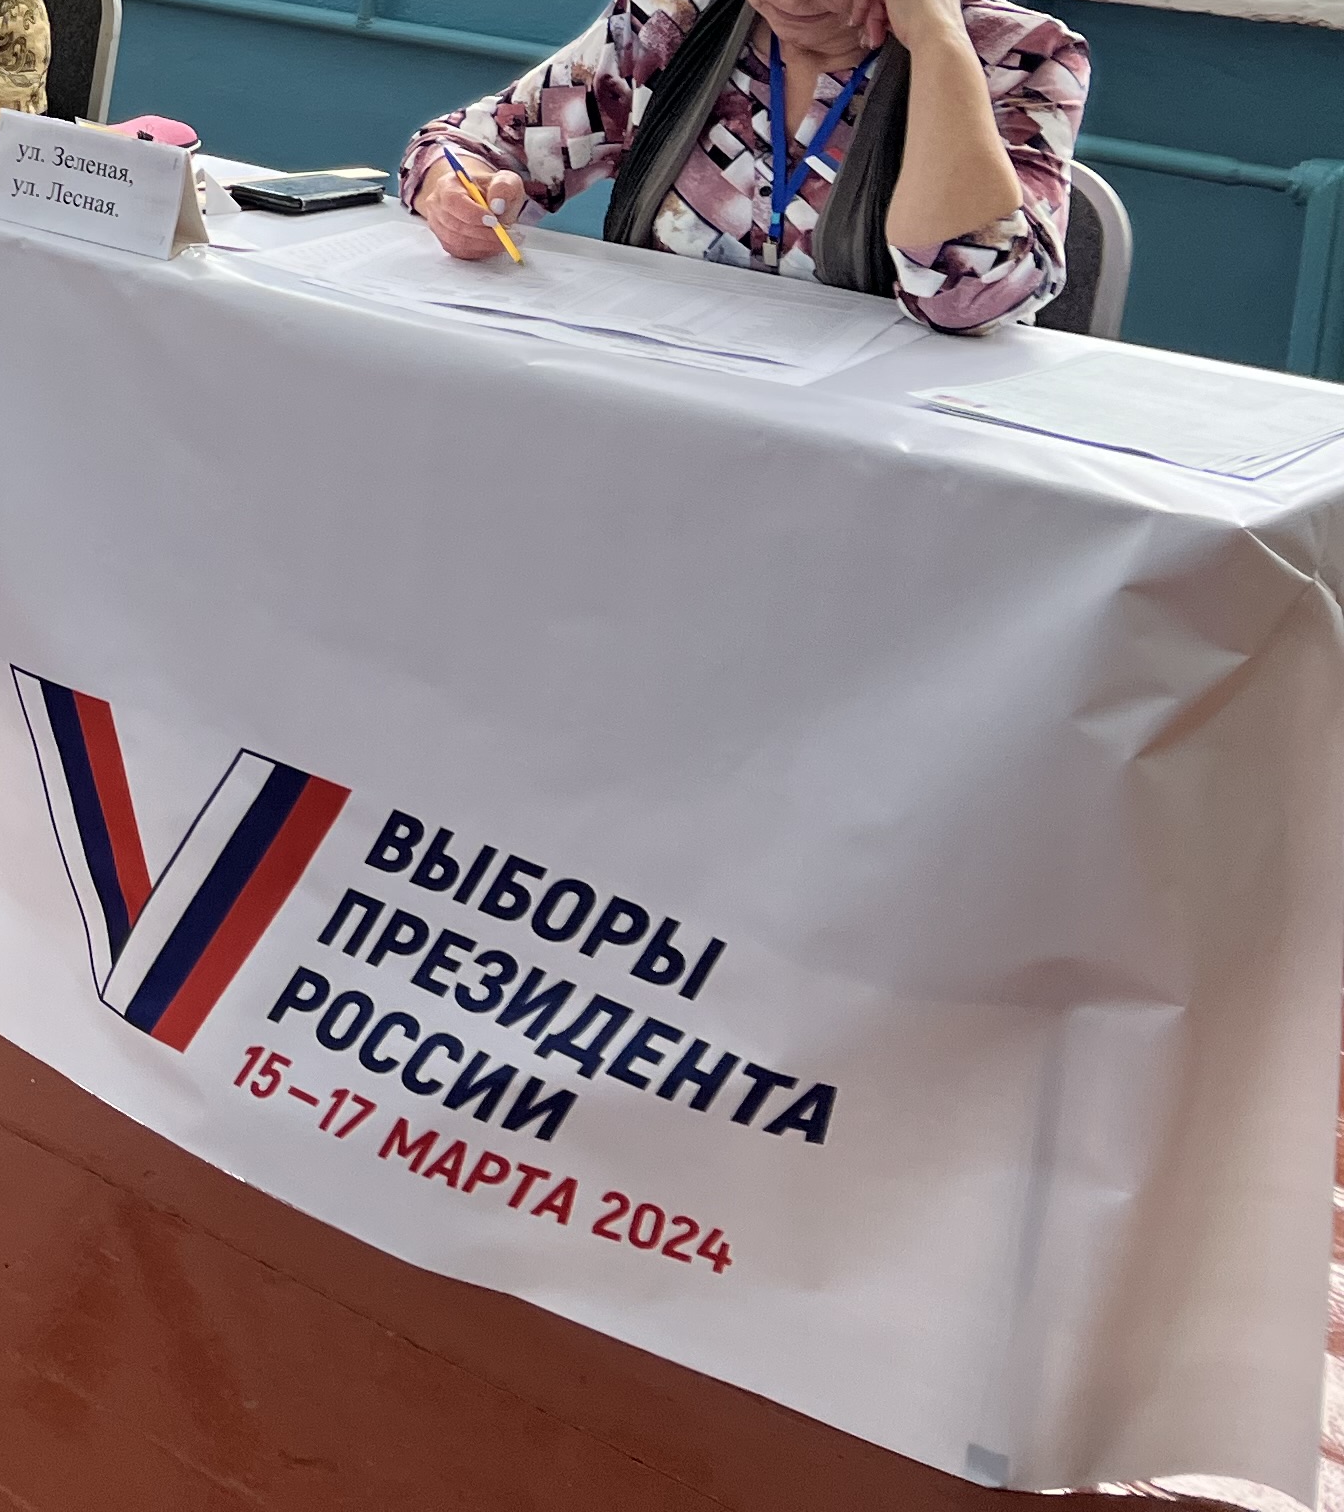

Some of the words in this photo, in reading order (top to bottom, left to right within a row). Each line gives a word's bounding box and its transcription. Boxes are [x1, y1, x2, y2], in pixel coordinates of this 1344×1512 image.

[11, 177, 40, 197] ул.
[45, 181, 119, 218] Лесная.
[15, 143, 45, 163] ул.
[51, 145, 134, 188] Зеленая,
[363, 807, 728, 1002] ВЫБОРЫ
[266, 965, 579, 1144] РОССИИ
[315, 887, 840, 1146] ПРЕЗИДЕНТА
[378, 1116, 579, 1227] МАРТА
[591, 1190, 734, 1275] 2024
